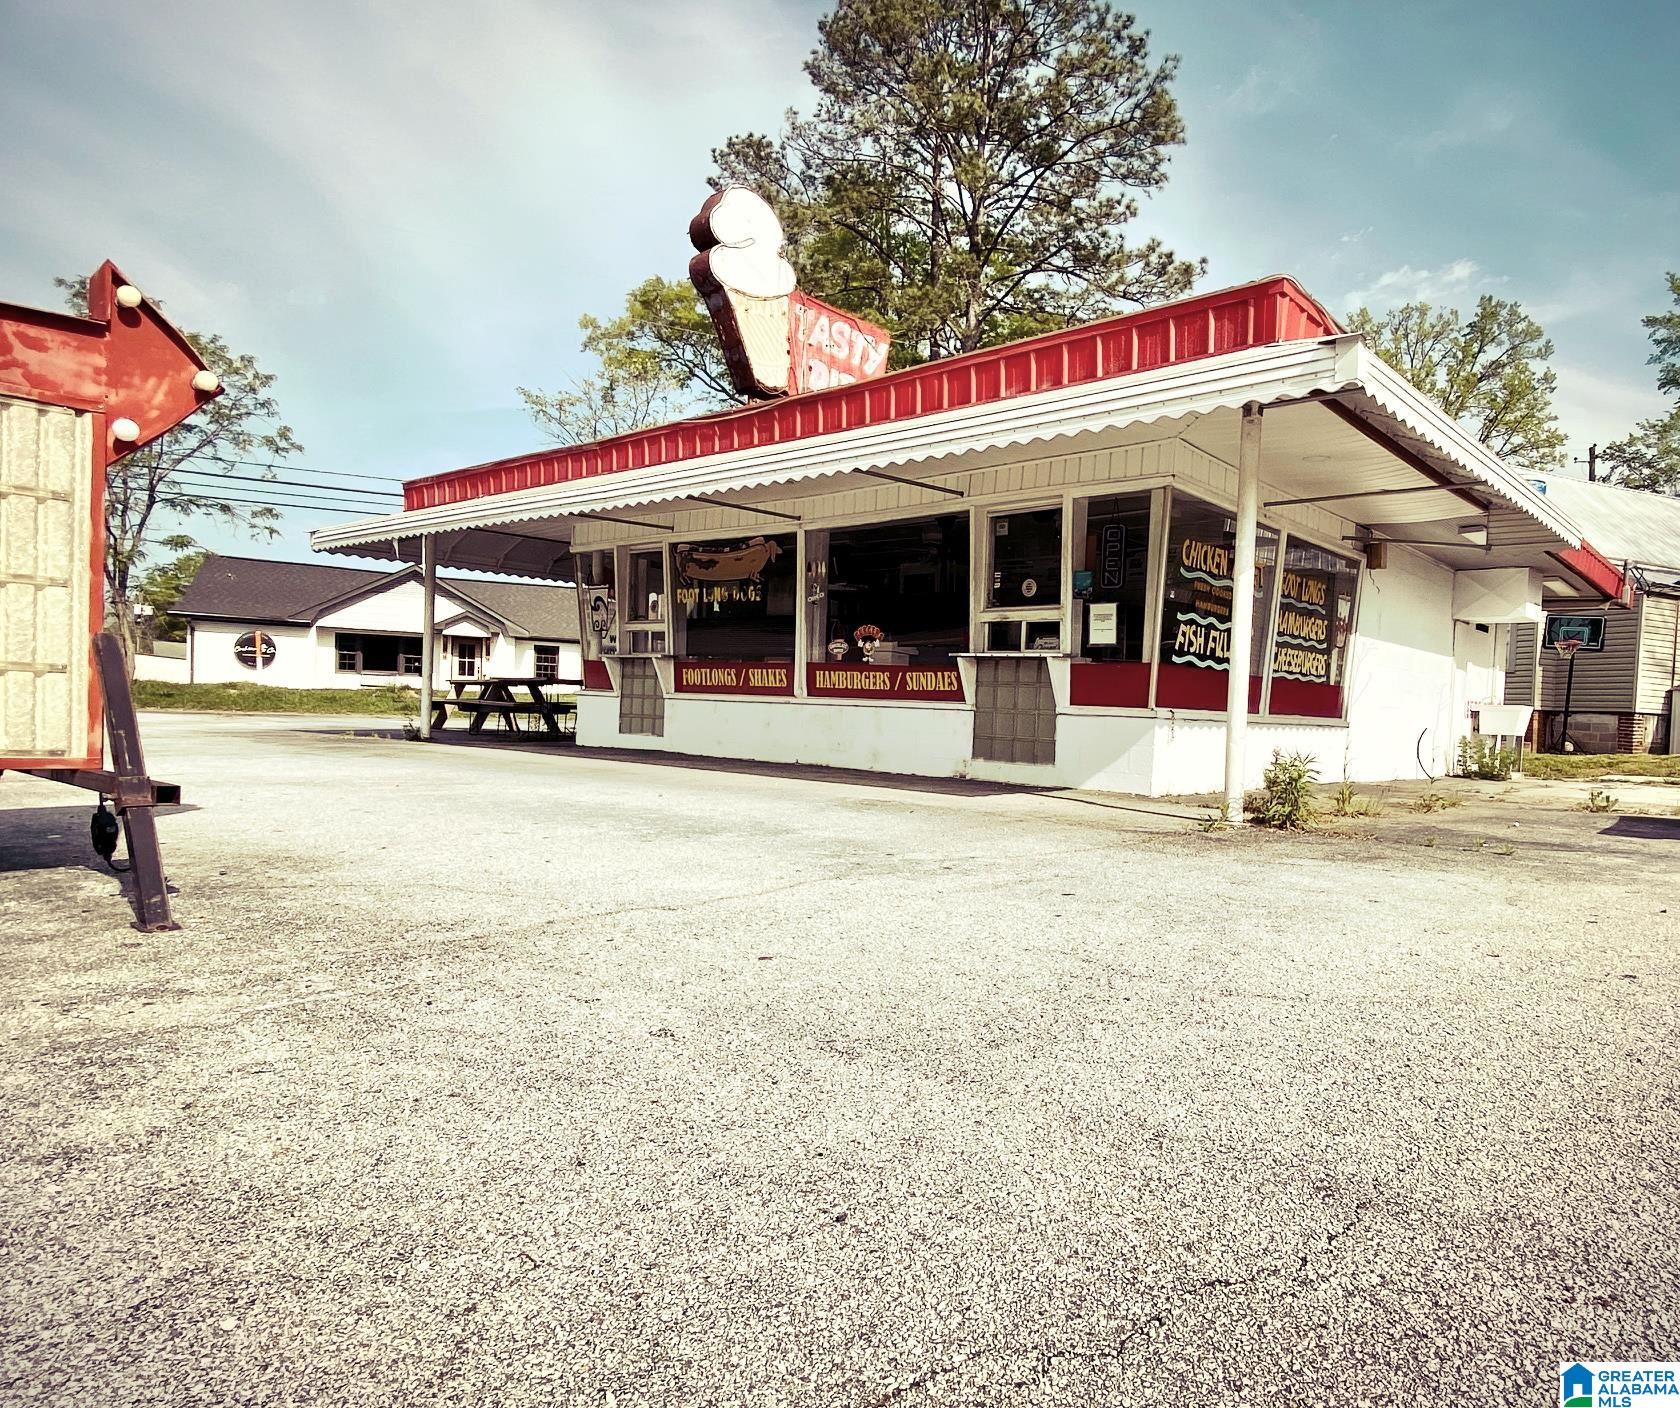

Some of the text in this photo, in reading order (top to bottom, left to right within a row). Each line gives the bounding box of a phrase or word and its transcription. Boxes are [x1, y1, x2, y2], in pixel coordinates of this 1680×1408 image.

[796, 303, 889, 375] TASTY
[1105, 529, 1121, 584] OPEN
[1182, 538, 1229, 576] CHICKEN
[676, 588, 700, 604] FOOT
[1301, 577, 1327, 605] LONGS
[1175, 623, 1205, 653] FISH
[1272, 646, 1328, 677] CHEESEBURGERS
[682, 668, 787, 688] FOOTLONGS / SHAKES
[815, 670, 958, 691] HAMBURGERS / SUNDAES
